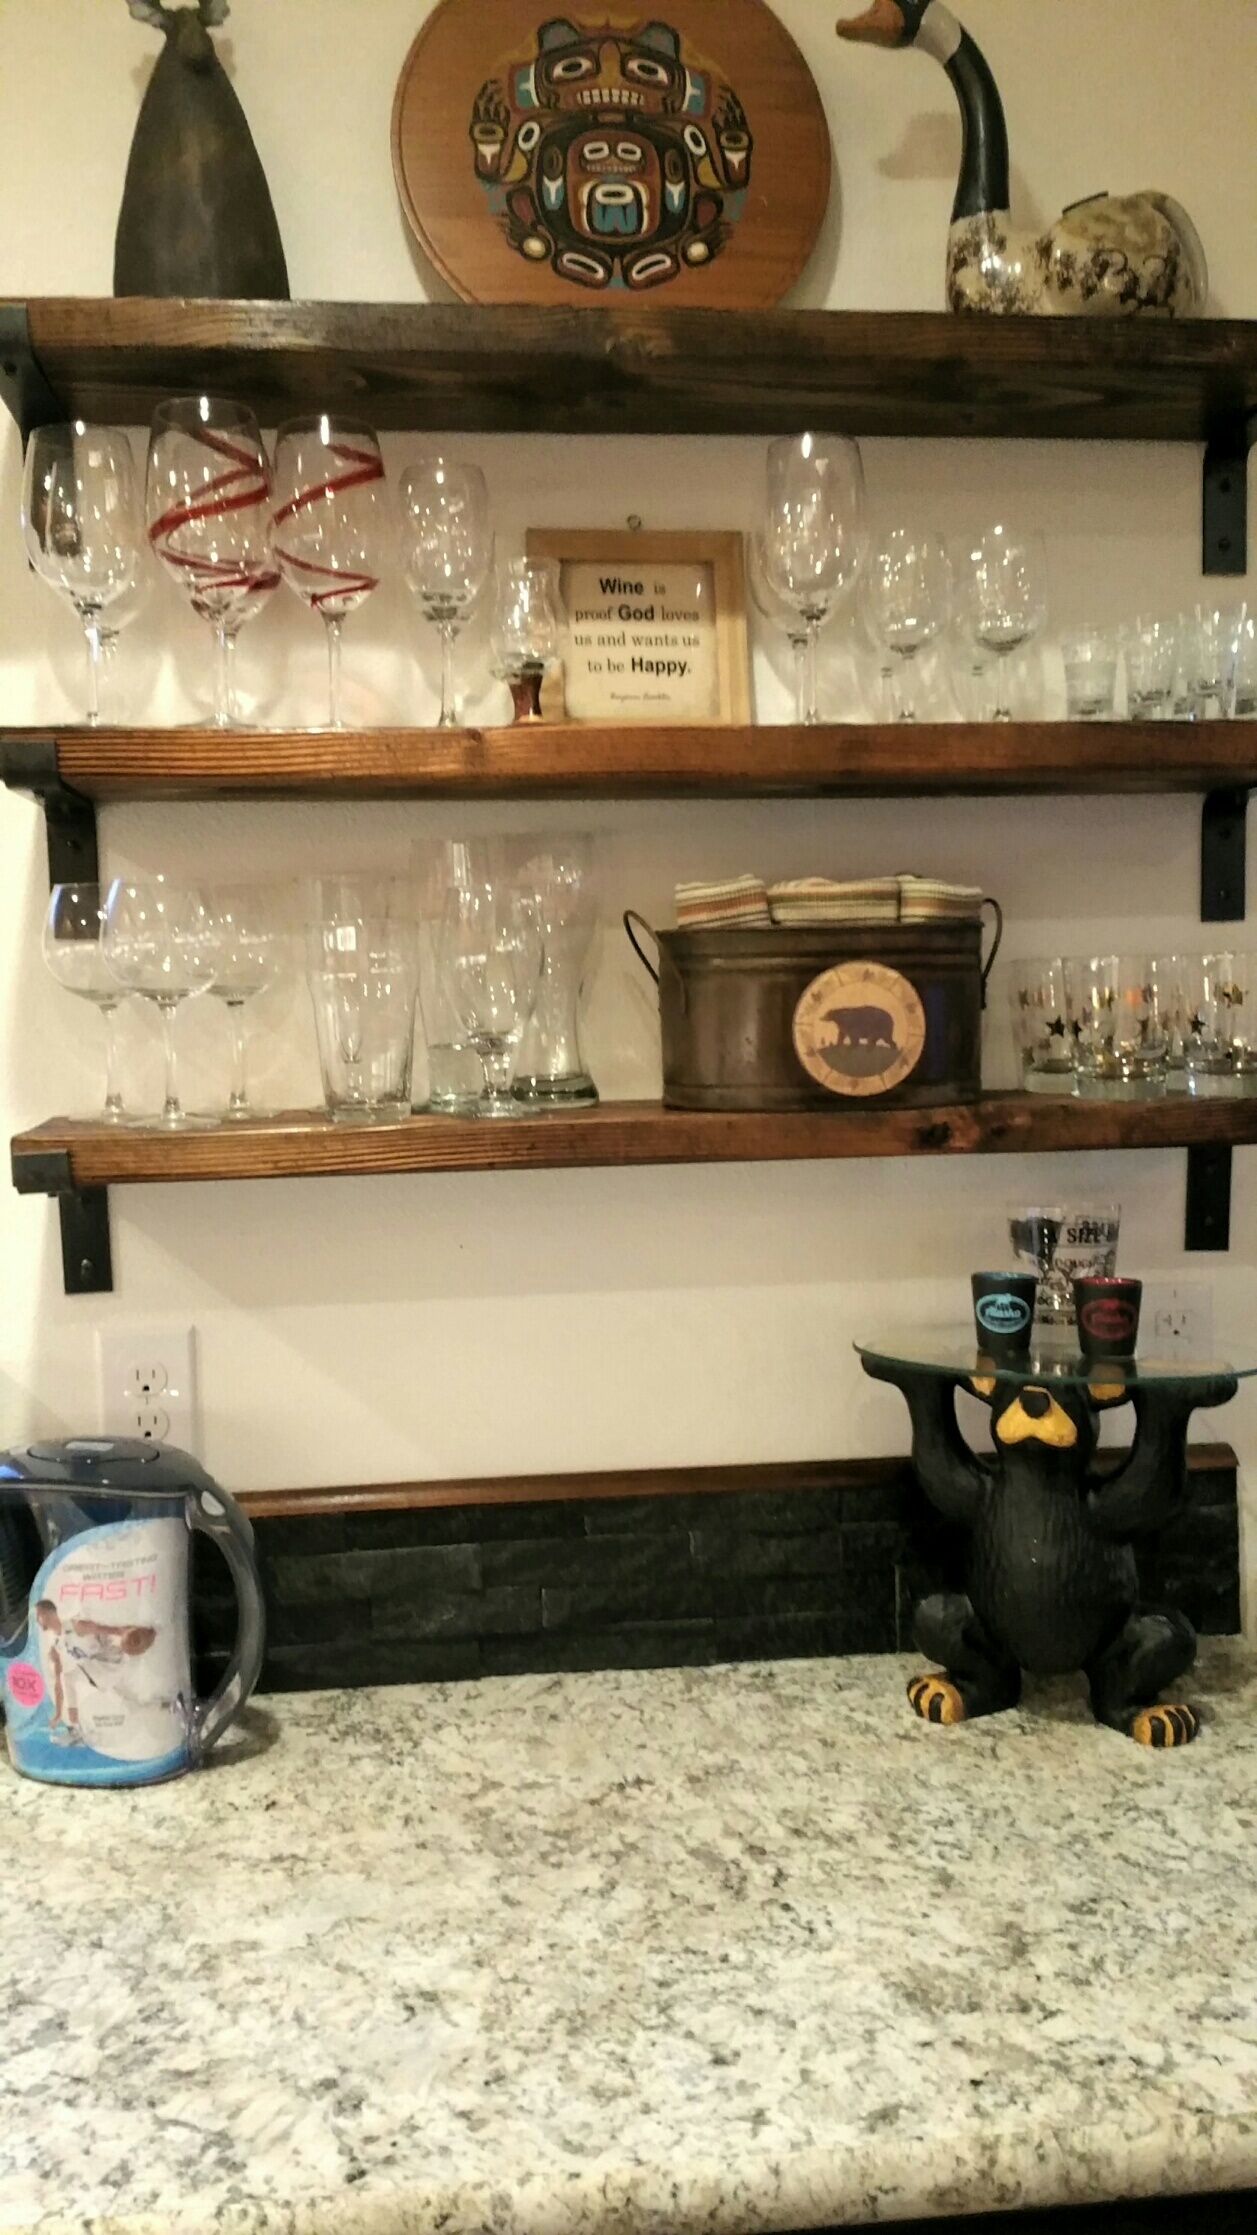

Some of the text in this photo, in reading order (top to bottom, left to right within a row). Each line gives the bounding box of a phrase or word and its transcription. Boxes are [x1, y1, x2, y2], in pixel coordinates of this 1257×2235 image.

[599, 578, 666, 595] Wine is
[575, 604, 699, 622] proof God loves
[574, 631, 700, 647] us and wants us
[587, 657, 692, 677] to be Happy.
[60, 1574, 156, 1602] FAST!
